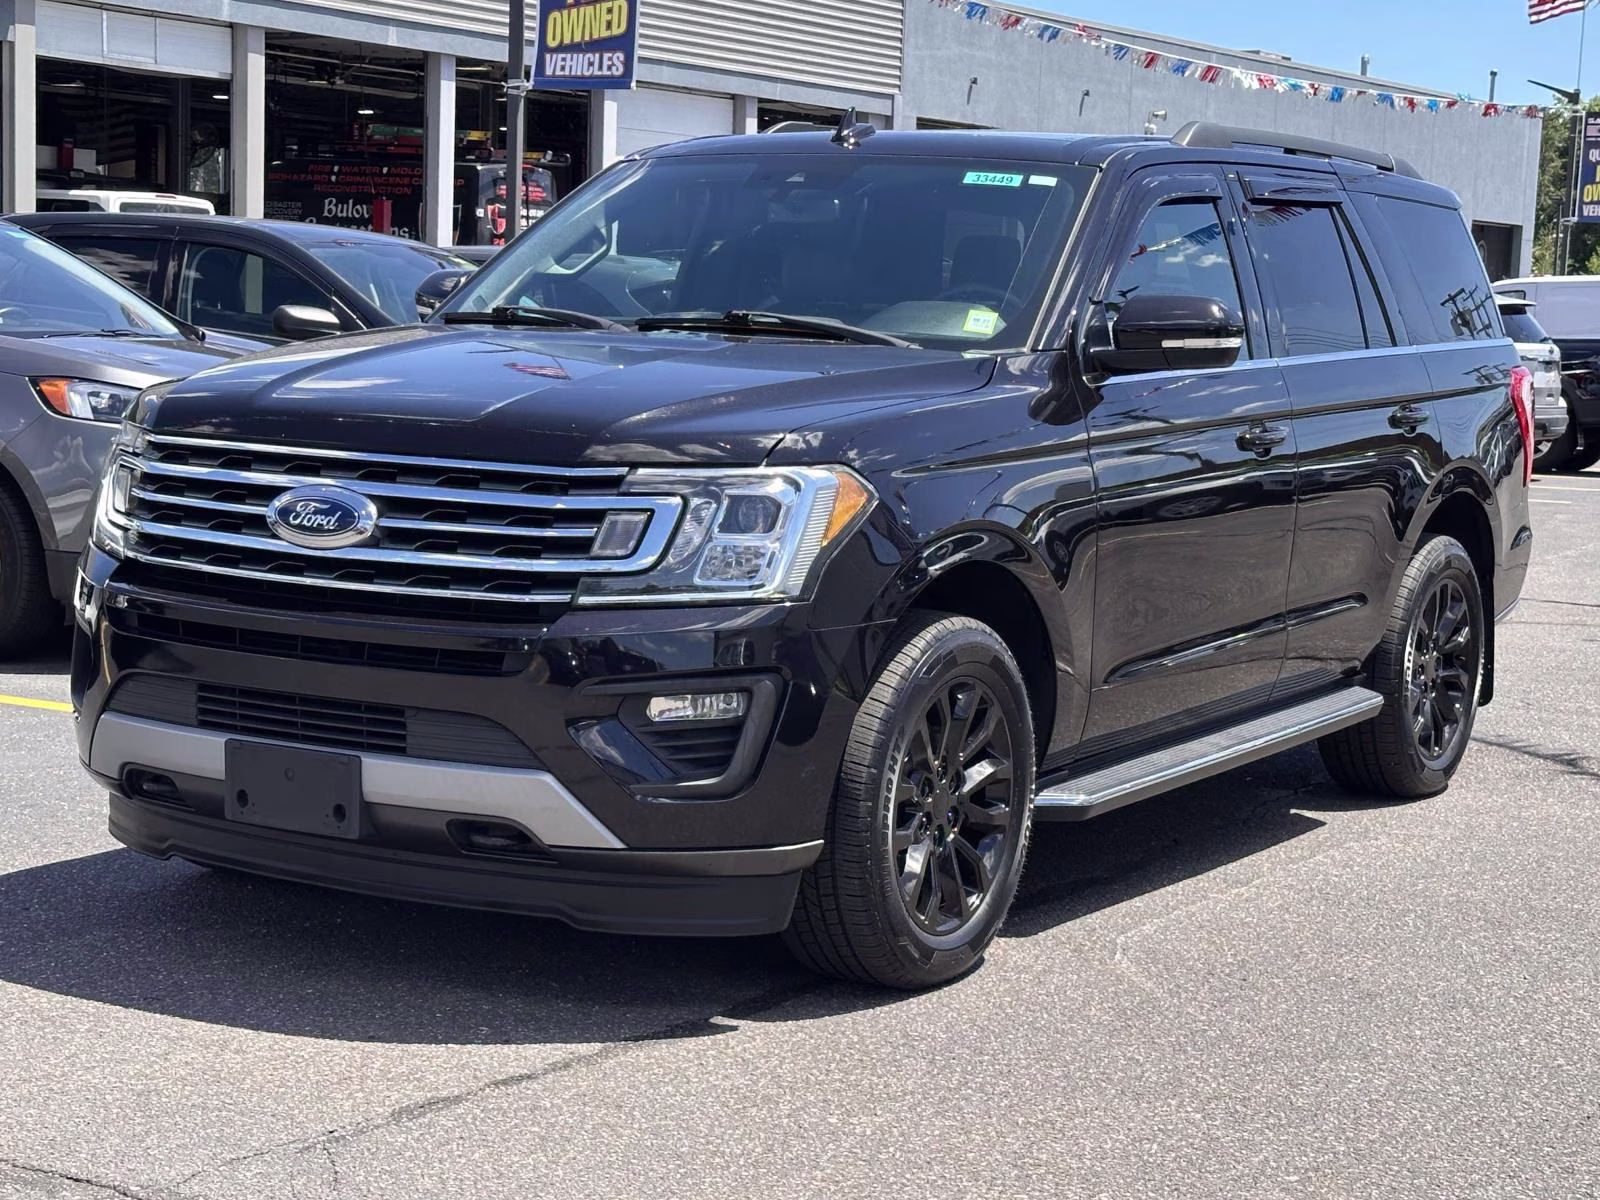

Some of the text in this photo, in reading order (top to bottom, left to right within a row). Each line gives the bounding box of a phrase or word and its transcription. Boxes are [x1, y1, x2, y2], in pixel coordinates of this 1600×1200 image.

[546, 0, 629, 48] OWNED
[545, 52, 625, 76] VEHICLES
[340, 166, 380, 175] WATER
[972, 174, 1013, 185] 33449
[289, 501, 342, 530] Ford
